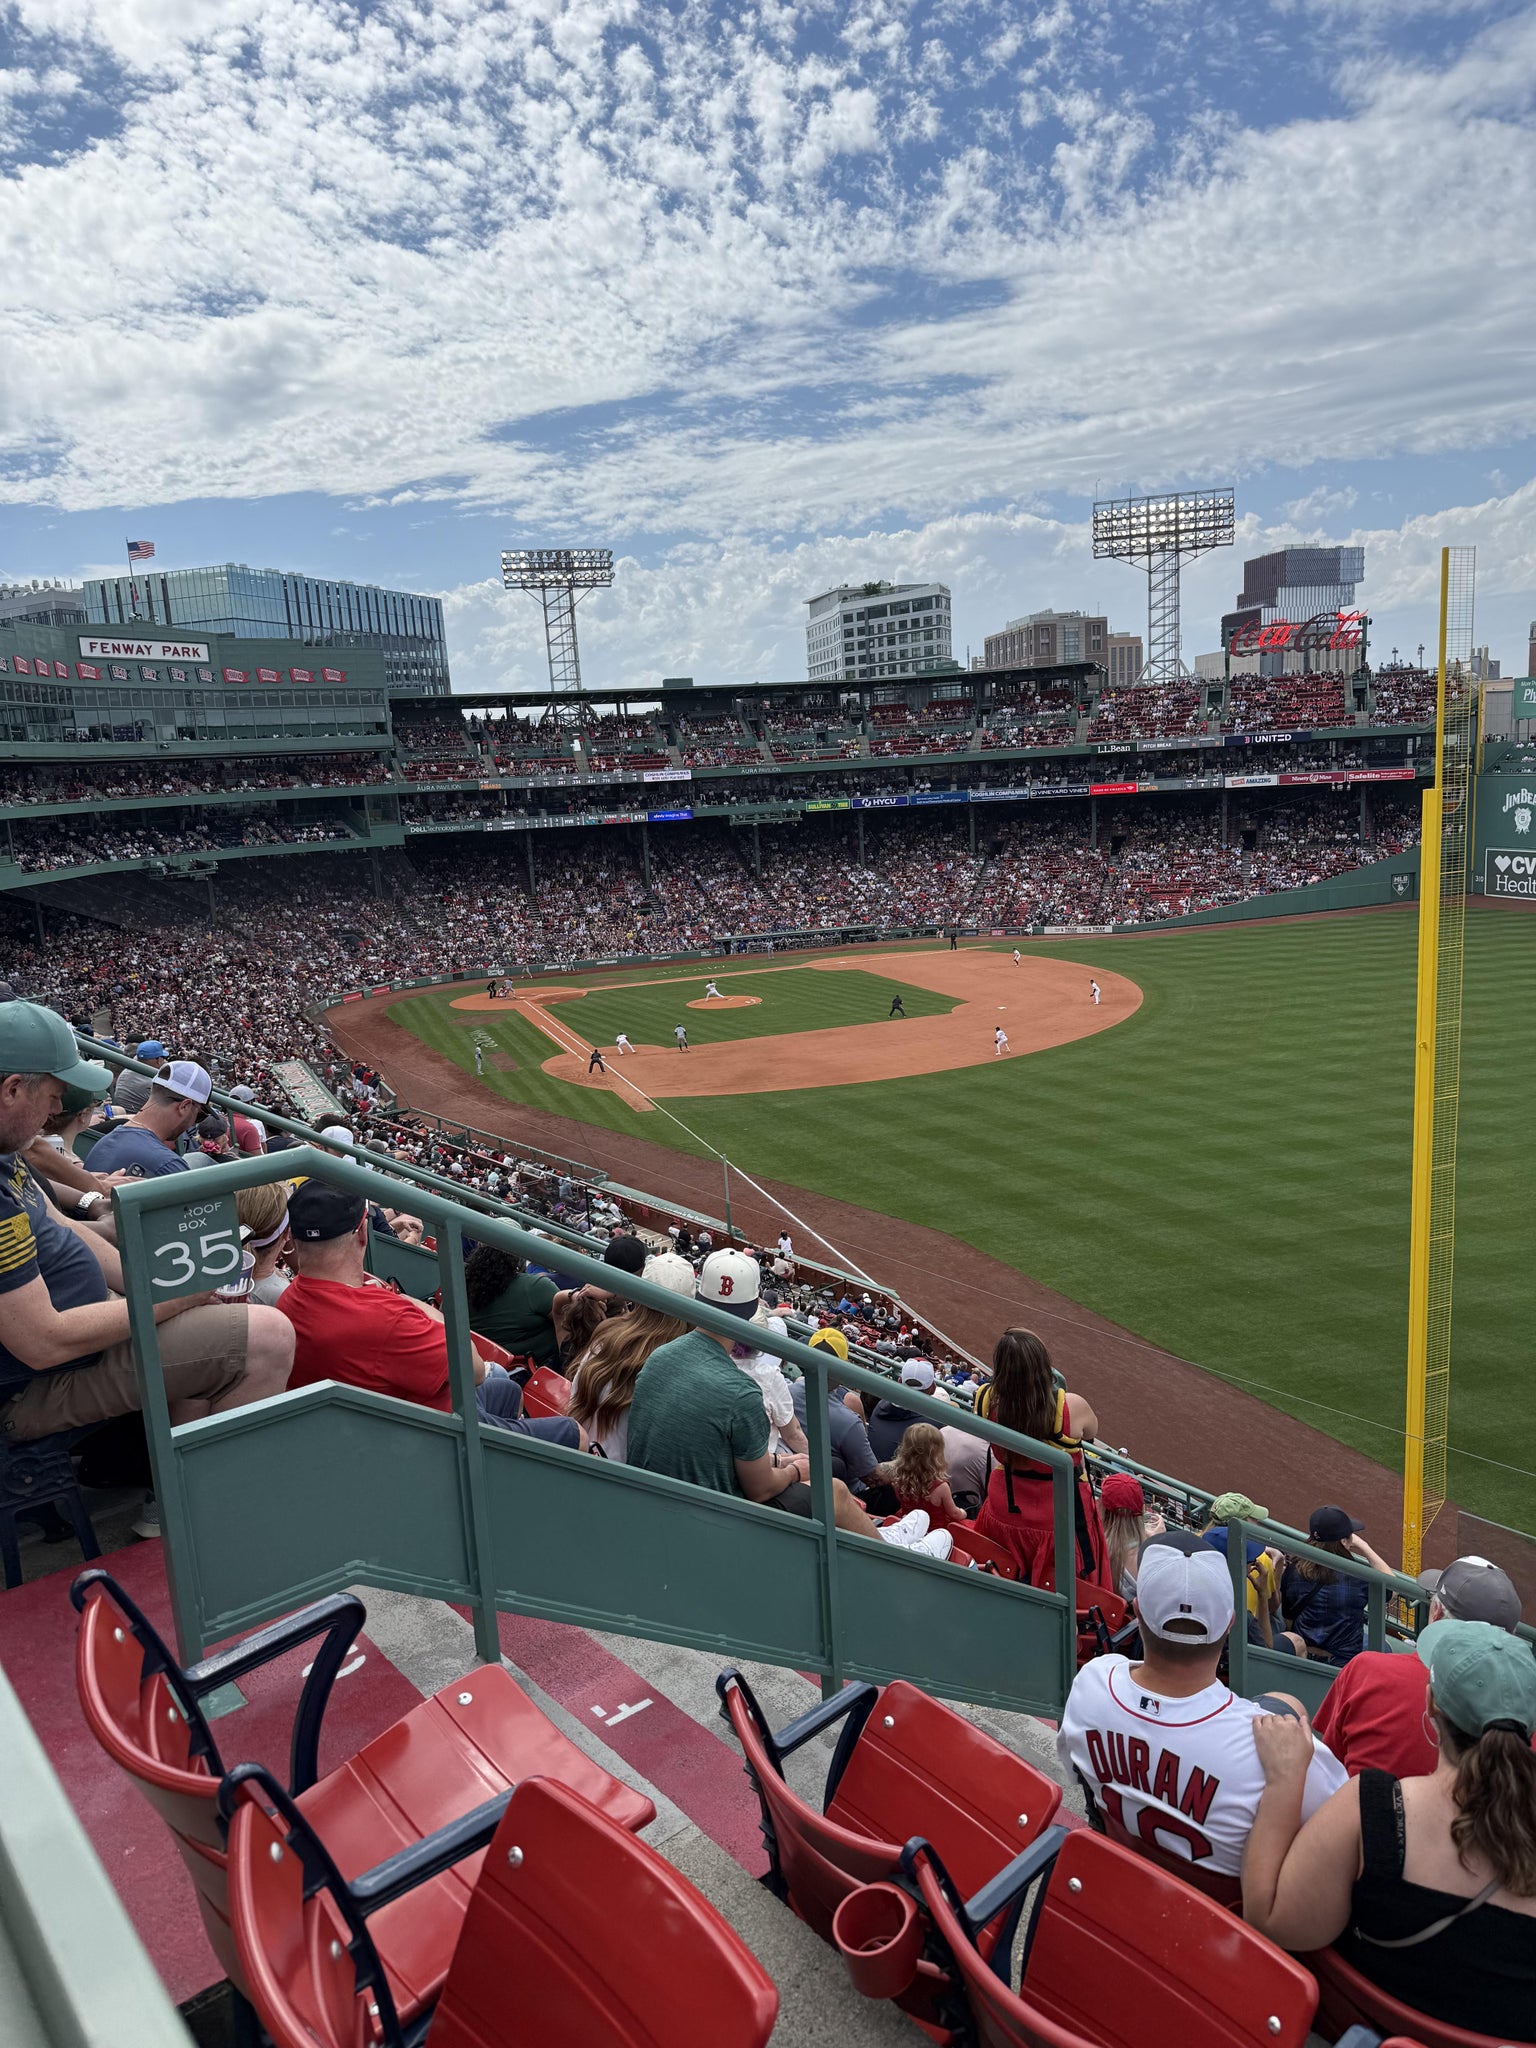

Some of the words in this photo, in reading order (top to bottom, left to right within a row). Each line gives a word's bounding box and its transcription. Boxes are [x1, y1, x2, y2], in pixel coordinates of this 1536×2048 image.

[89, 641, 153, 656] FENWAY
[162, 645, 202, 658] PARK
[1255, 734, 1292, 743] UNITED
[1098, 745, 1130, 754] L.L.Bean
[183, 1202, 222, 1219] ROOF
[178, 1217, 207, 1232] BOX
[151, 1229, 240, 1287] 35
[718, 1275, 735, 1296] B
[1085, 1729, 1220, 1826] DURAN
